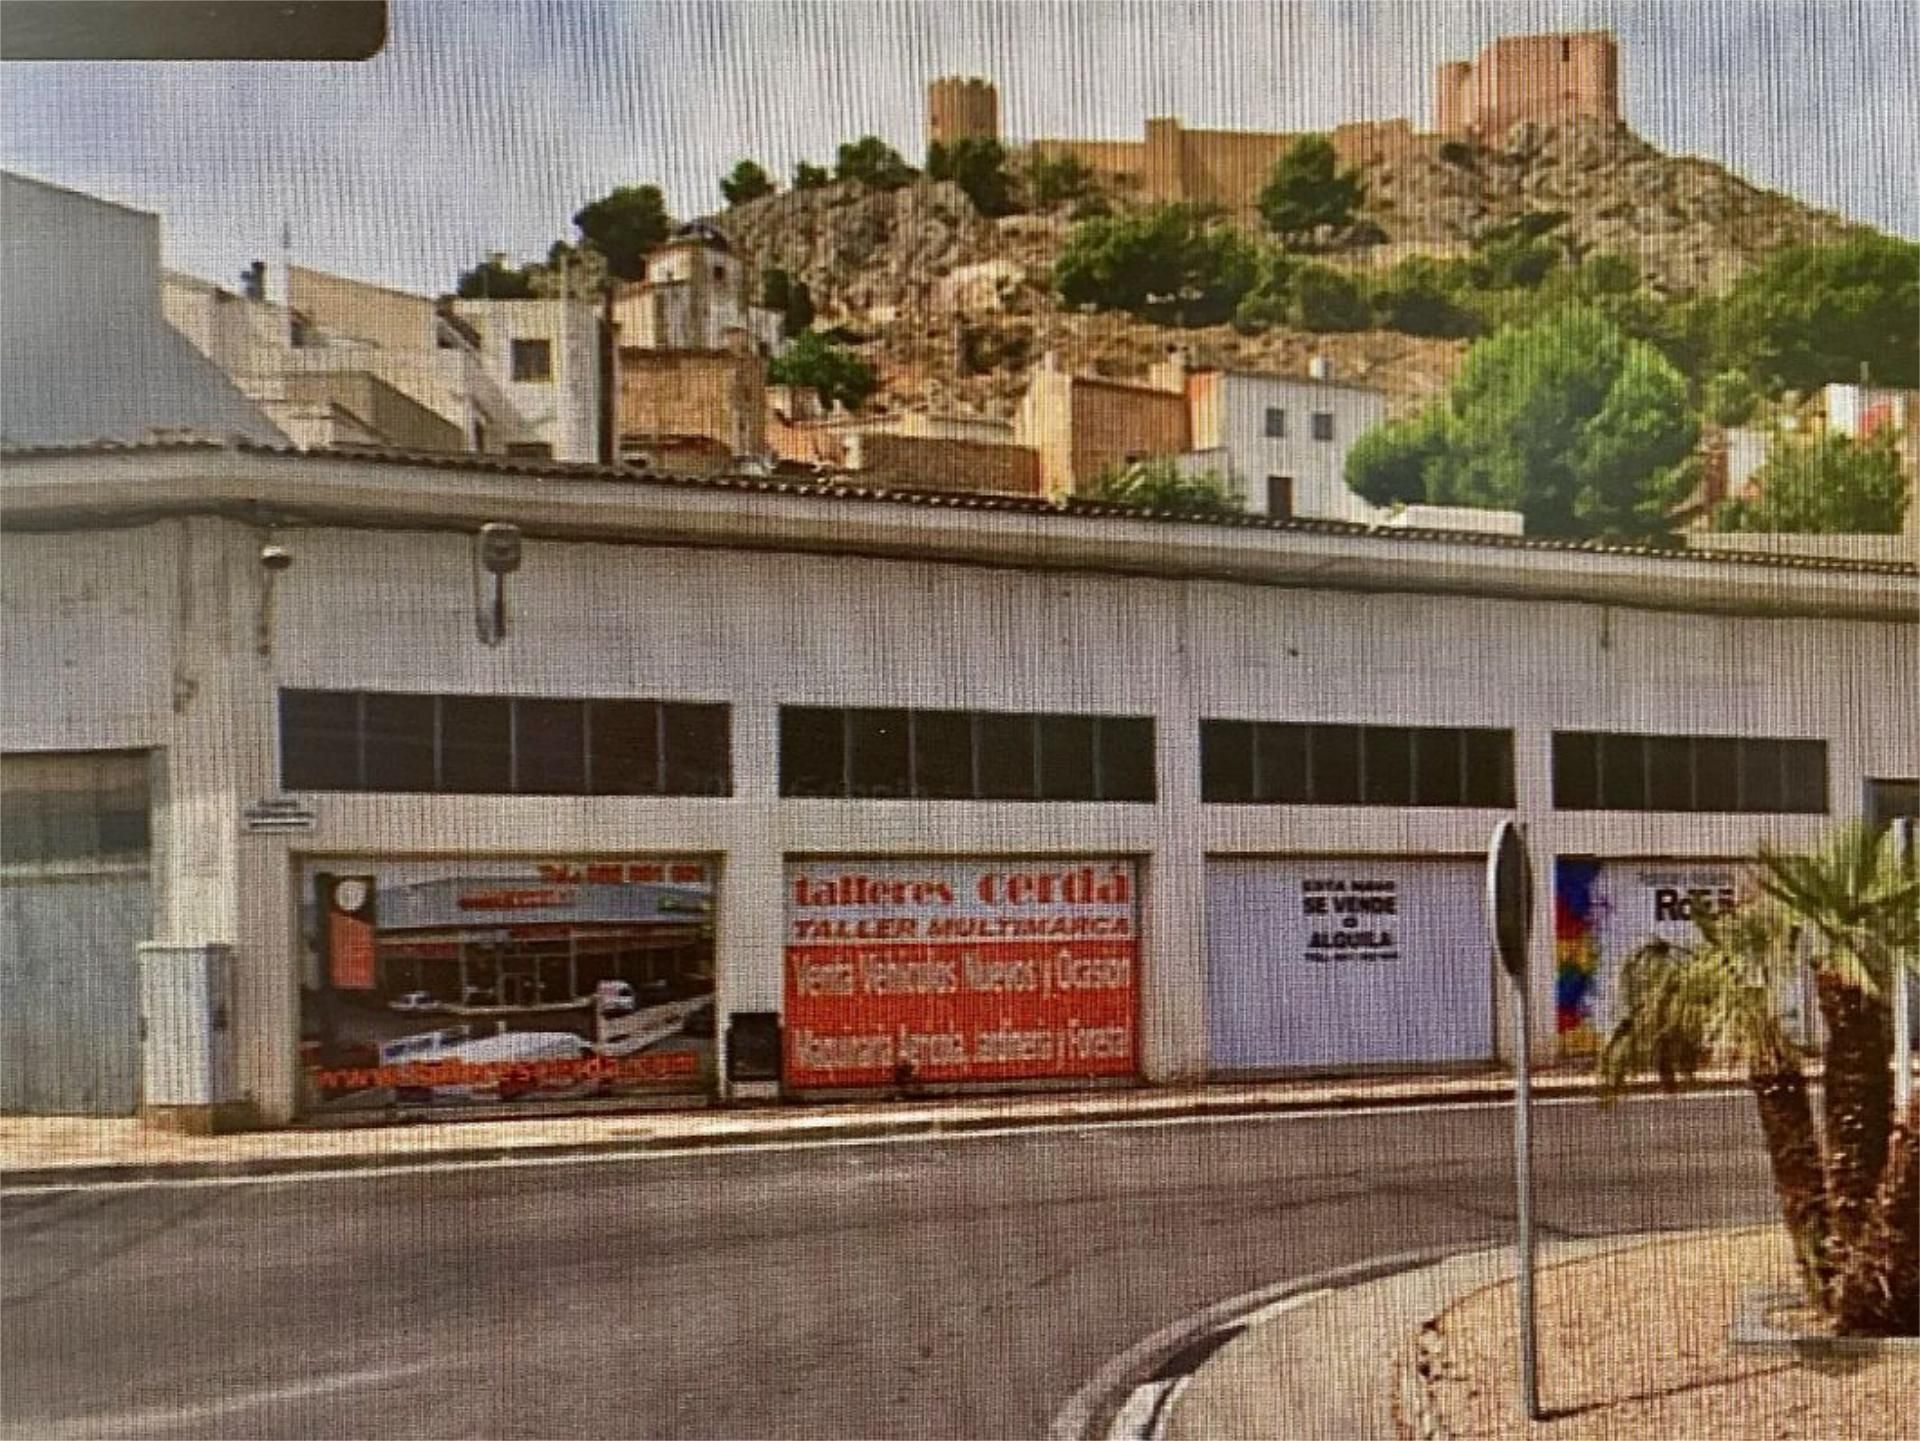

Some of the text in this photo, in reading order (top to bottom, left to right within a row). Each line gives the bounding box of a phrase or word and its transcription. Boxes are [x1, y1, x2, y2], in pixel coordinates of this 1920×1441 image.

[794, 873, 954, 908] talleres
[1303, 896, 1397, 914] SE VENDE
[792, 915, 1130, 939] TALLER MULTIMARCA
[1308, 931, 1393, 948] ALQUILA
